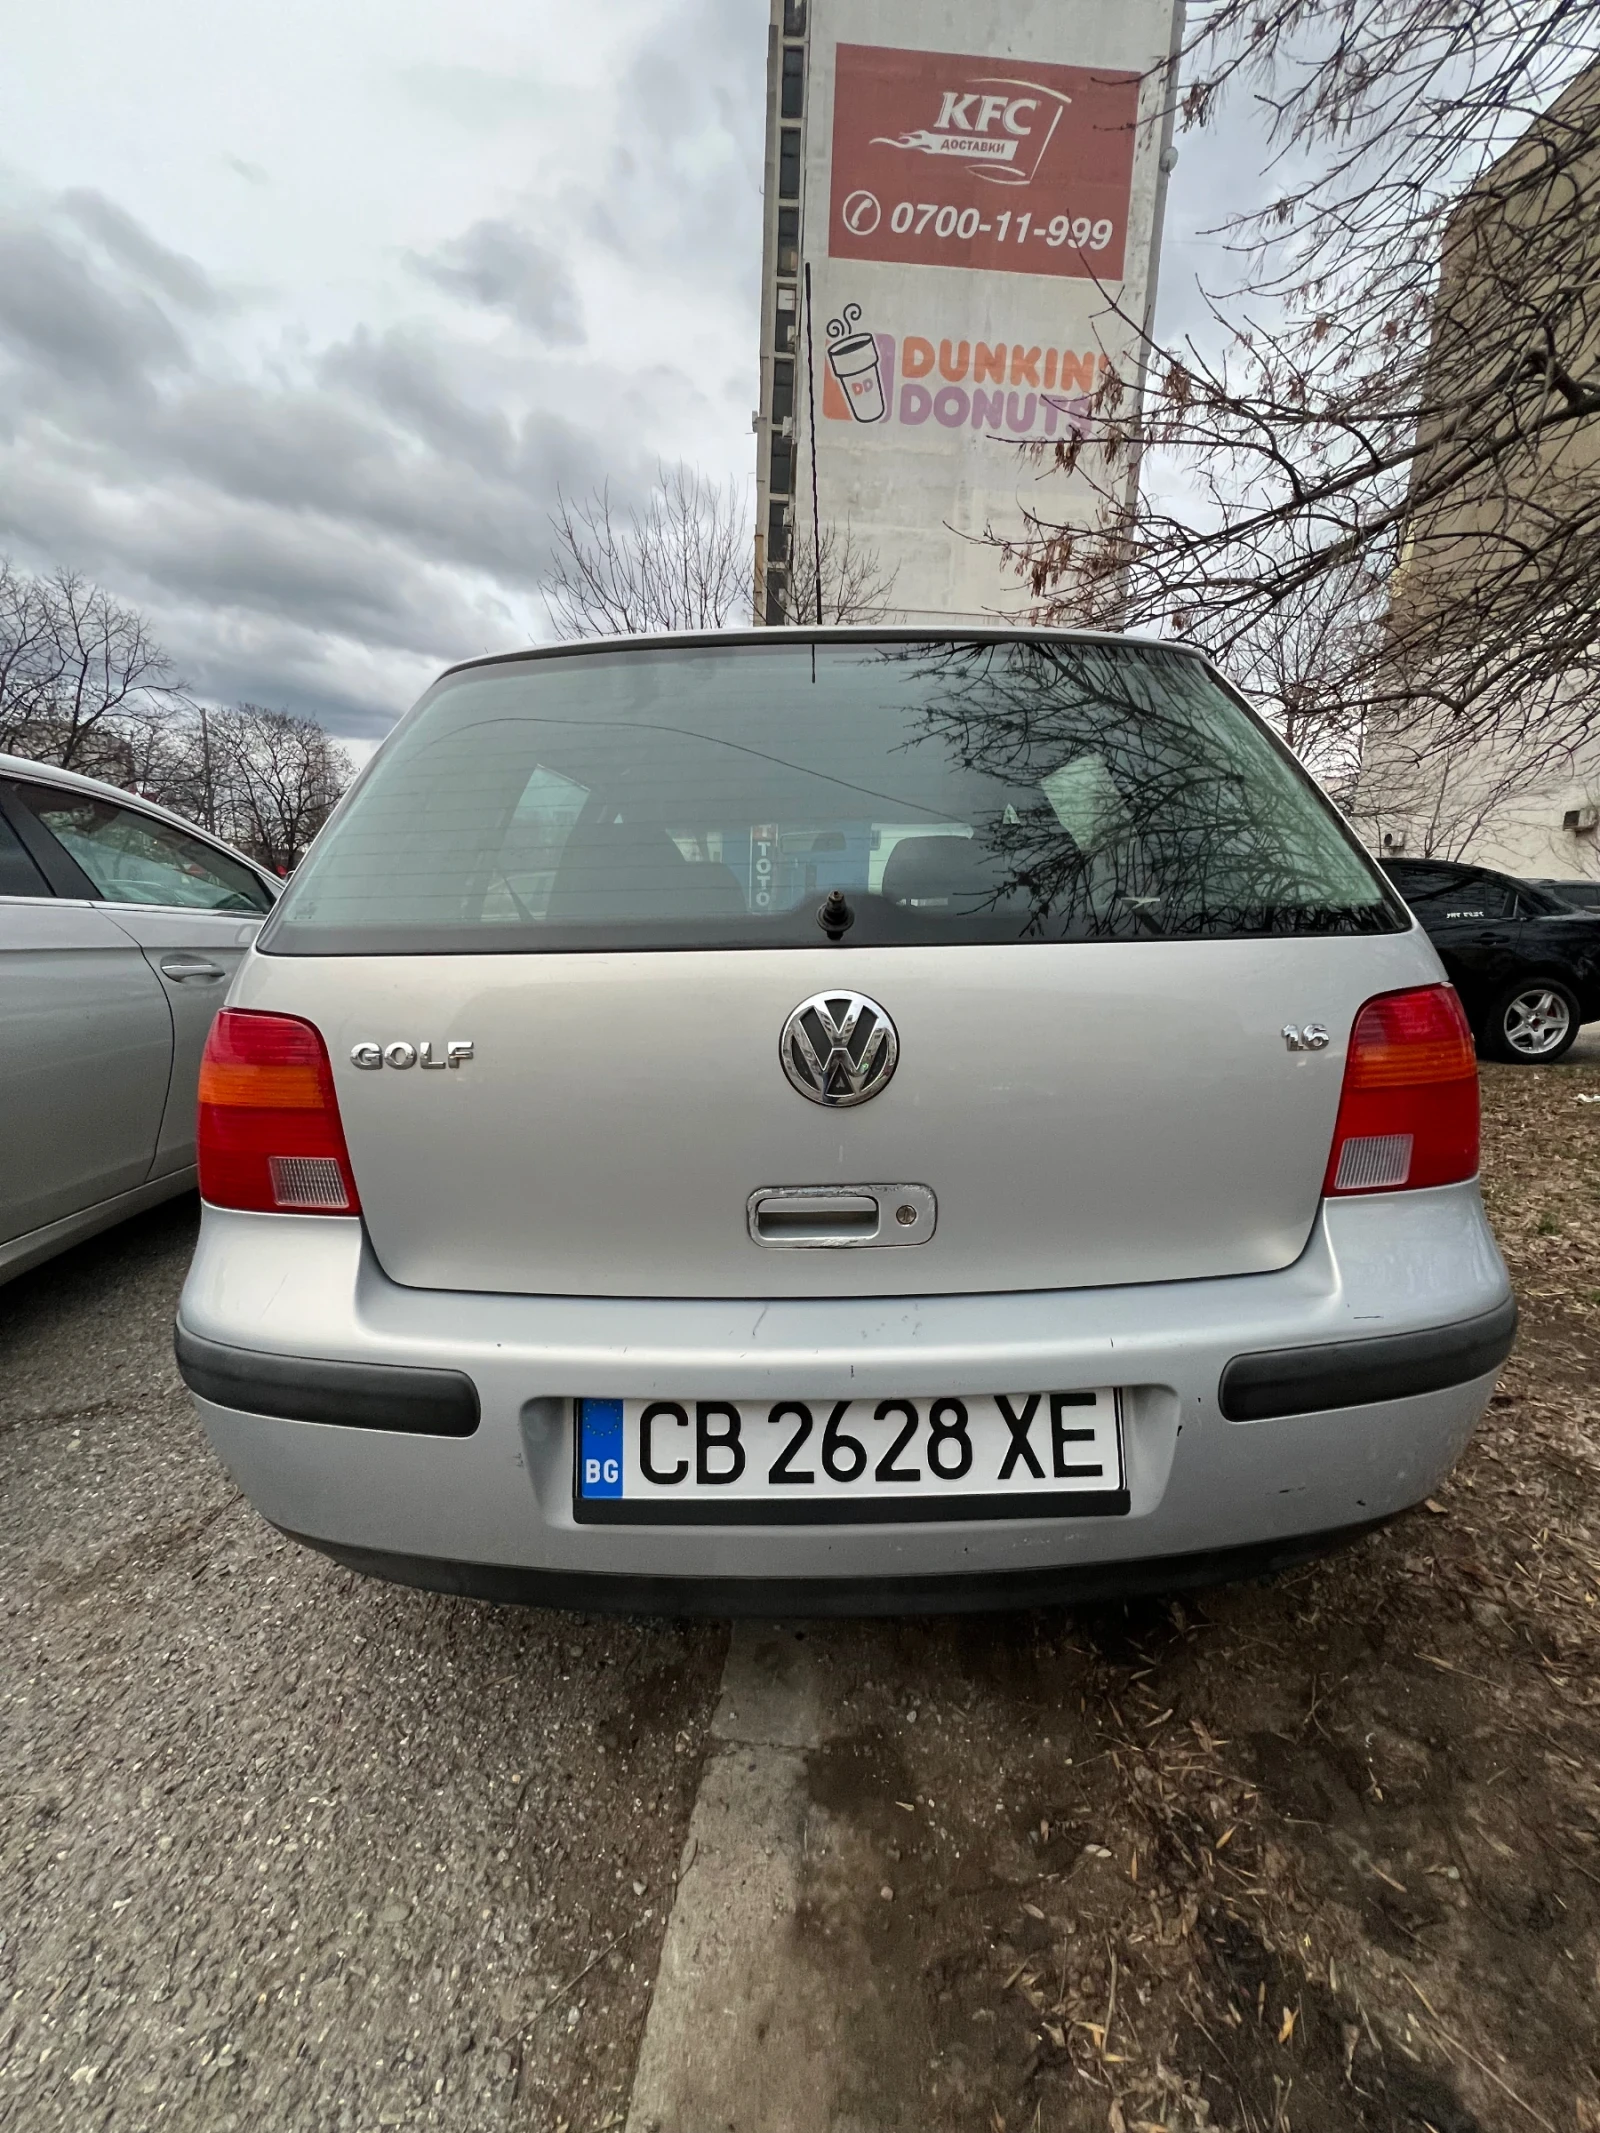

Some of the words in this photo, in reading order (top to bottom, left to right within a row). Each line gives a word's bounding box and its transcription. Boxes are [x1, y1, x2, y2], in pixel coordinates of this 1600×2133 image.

[933, 91, 1037, 135] KFC
[940, 138, 1006, 154] ДОСТАВКИ
[890, 202, 1114, 250] 0700-11-999
[900, 383, 1093, 440] DONUTS
[350, 1041, 474, 1070] GOLF
[1281, 1023, 1330, 1052] 1.6
[639, 1400, 746, 1485] CB
[767, 1397, 974, 1484] 2628
[993, 1392, 1104, 1481] XE
[585, 1459, 619, 1484] BG
